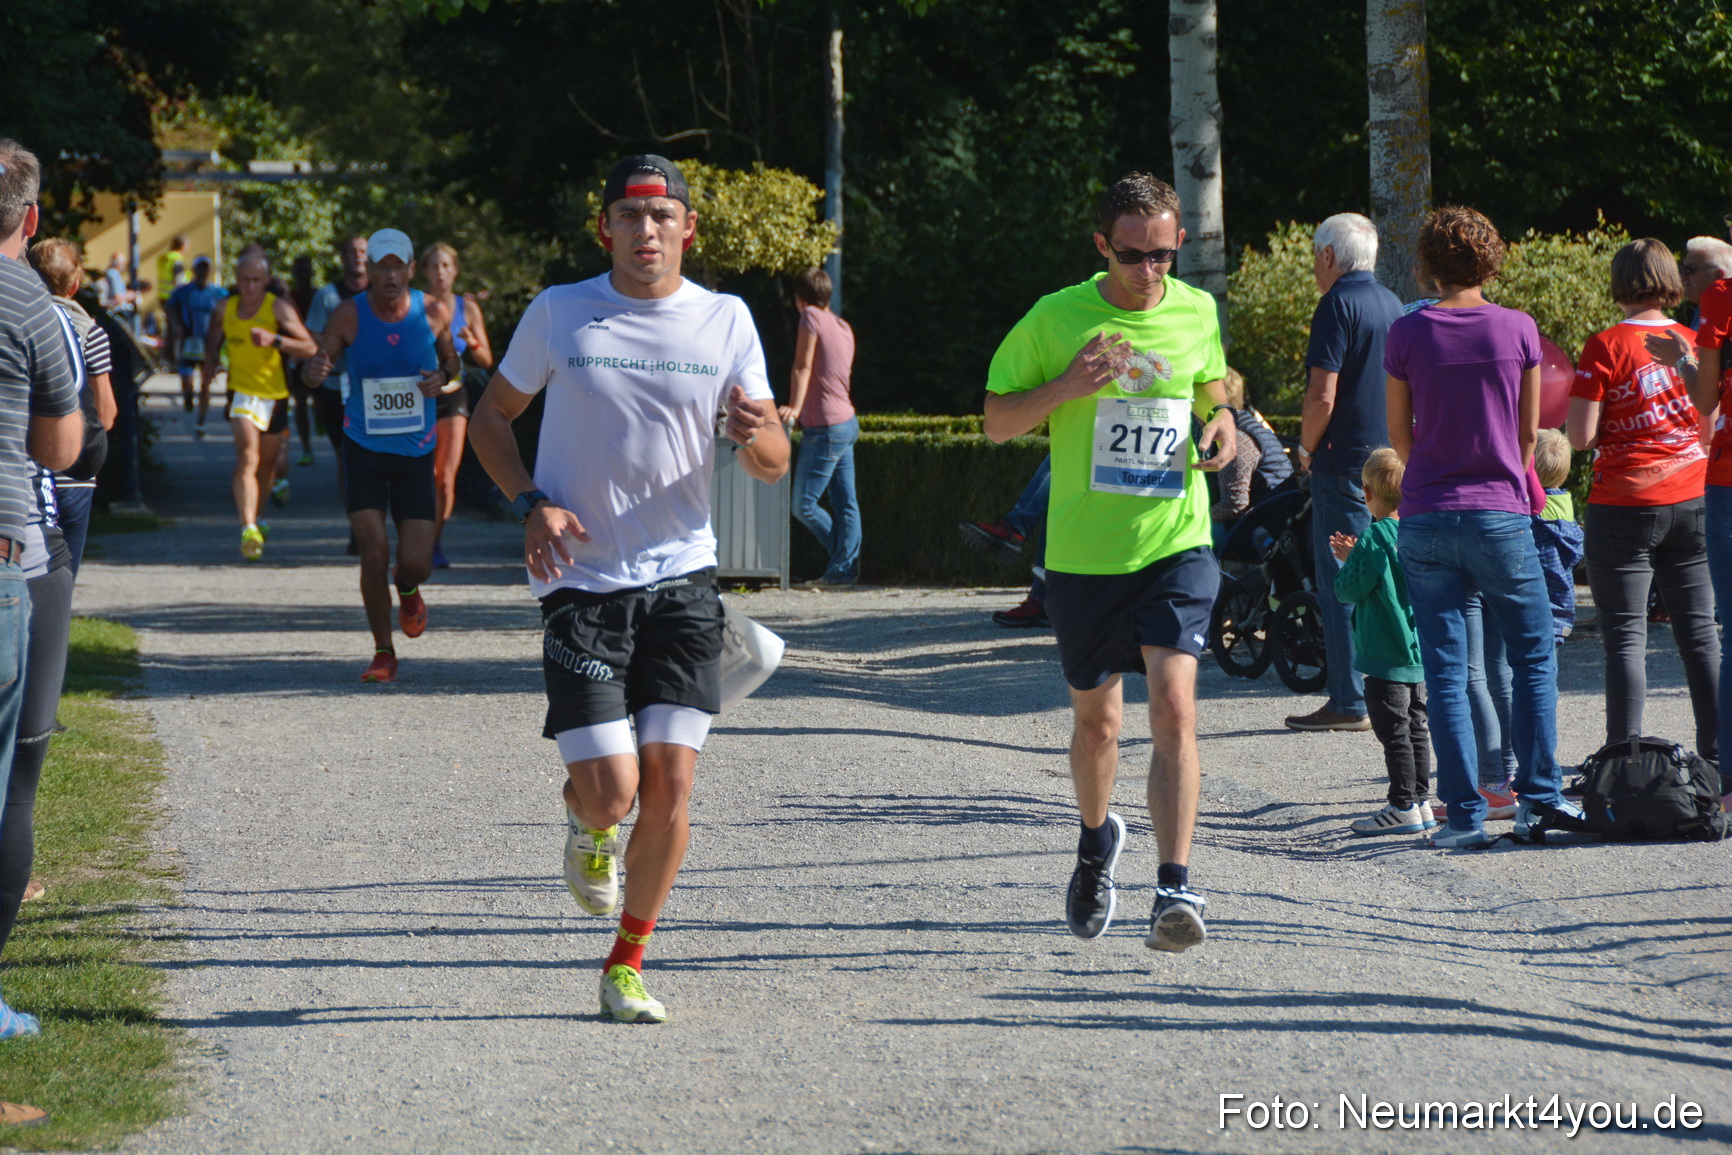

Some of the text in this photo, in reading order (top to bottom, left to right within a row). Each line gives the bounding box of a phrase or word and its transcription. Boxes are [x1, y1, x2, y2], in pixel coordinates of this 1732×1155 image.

[568, 356, 719, 376] RUPPRECHT HOLZBAU
[373, 392, 415, 411] 3008
[1127, 405, 1169, 419] BOCK
[1109, 423, 1178, 456] 2172
[1114, 457, 1136, 465] PARTL
[1121, 471, 1166, 486] Torsten
